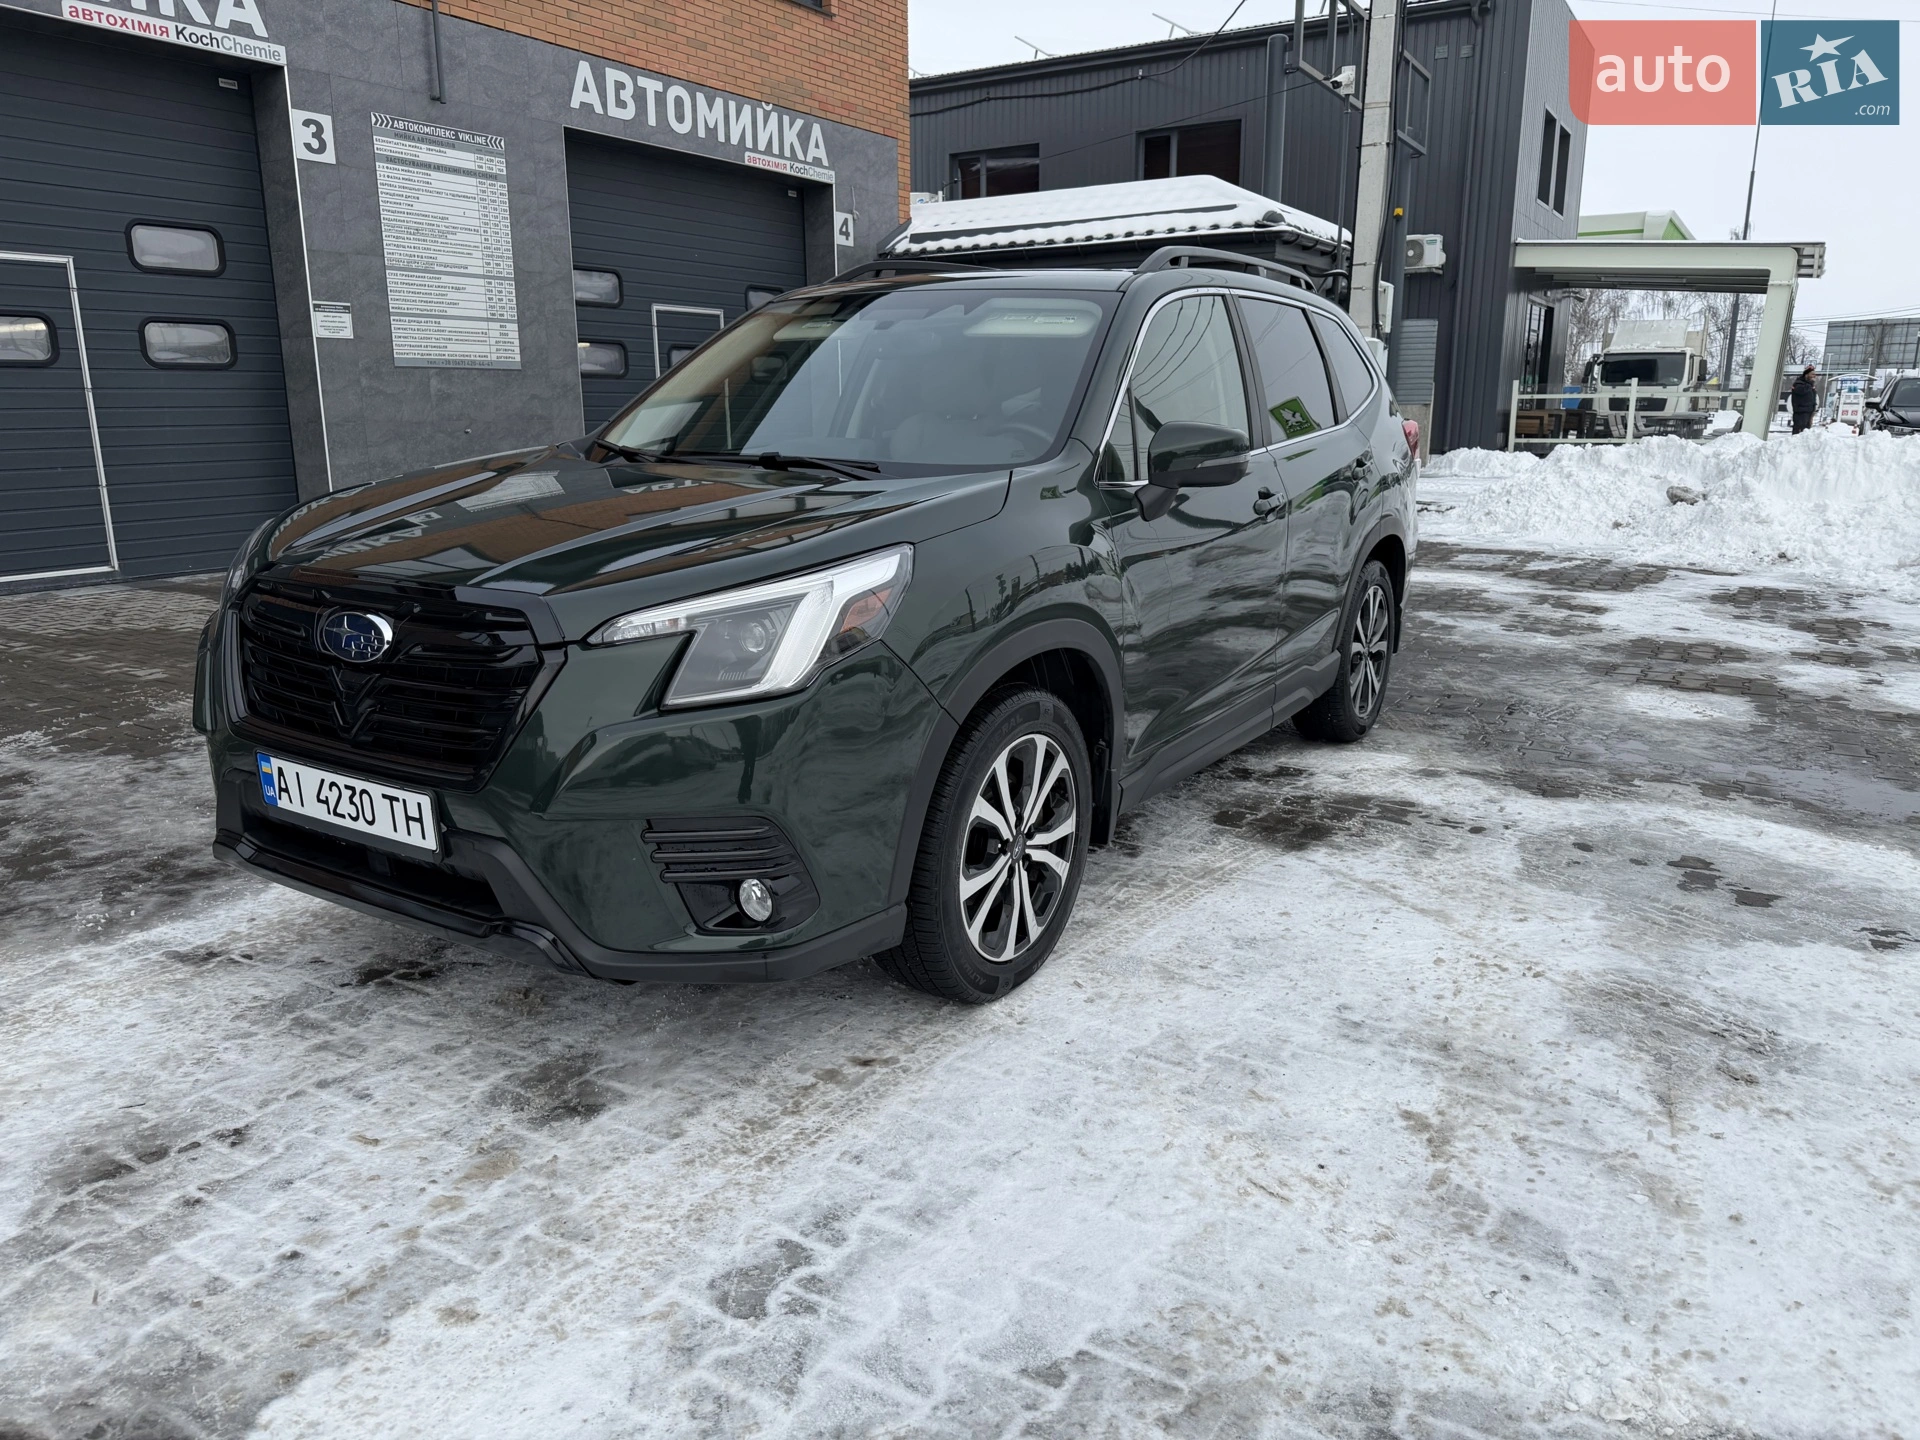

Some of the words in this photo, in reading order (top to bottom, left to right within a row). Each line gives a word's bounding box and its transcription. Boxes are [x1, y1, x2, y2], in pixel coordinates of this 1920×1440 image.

[68, 5, 170, 38] автохімія
[570, 60, 829, 166] АВТОМИЙКА
[302, 118, 327, 155] 3
[392, 119, 456, 139] АВТОКОМПЛЕКС
[458, 132, 487, 145] VIKLINE
[394, 131, 416, 142] МИЙКА
[416, 135, 456, 149] АВТОМОБІЛІВ
[386, 156, 432, 170] ЗАСТОСУВАННЯ
[747, 155, 787, 172] автохімія
[838, 217, 850, 241] 4
[265, 785, 276, 798] UA
[277, 766, 305, 808] AI
[316, 778, 376, 826] 4230
[381, 793, 427, 841] TH
